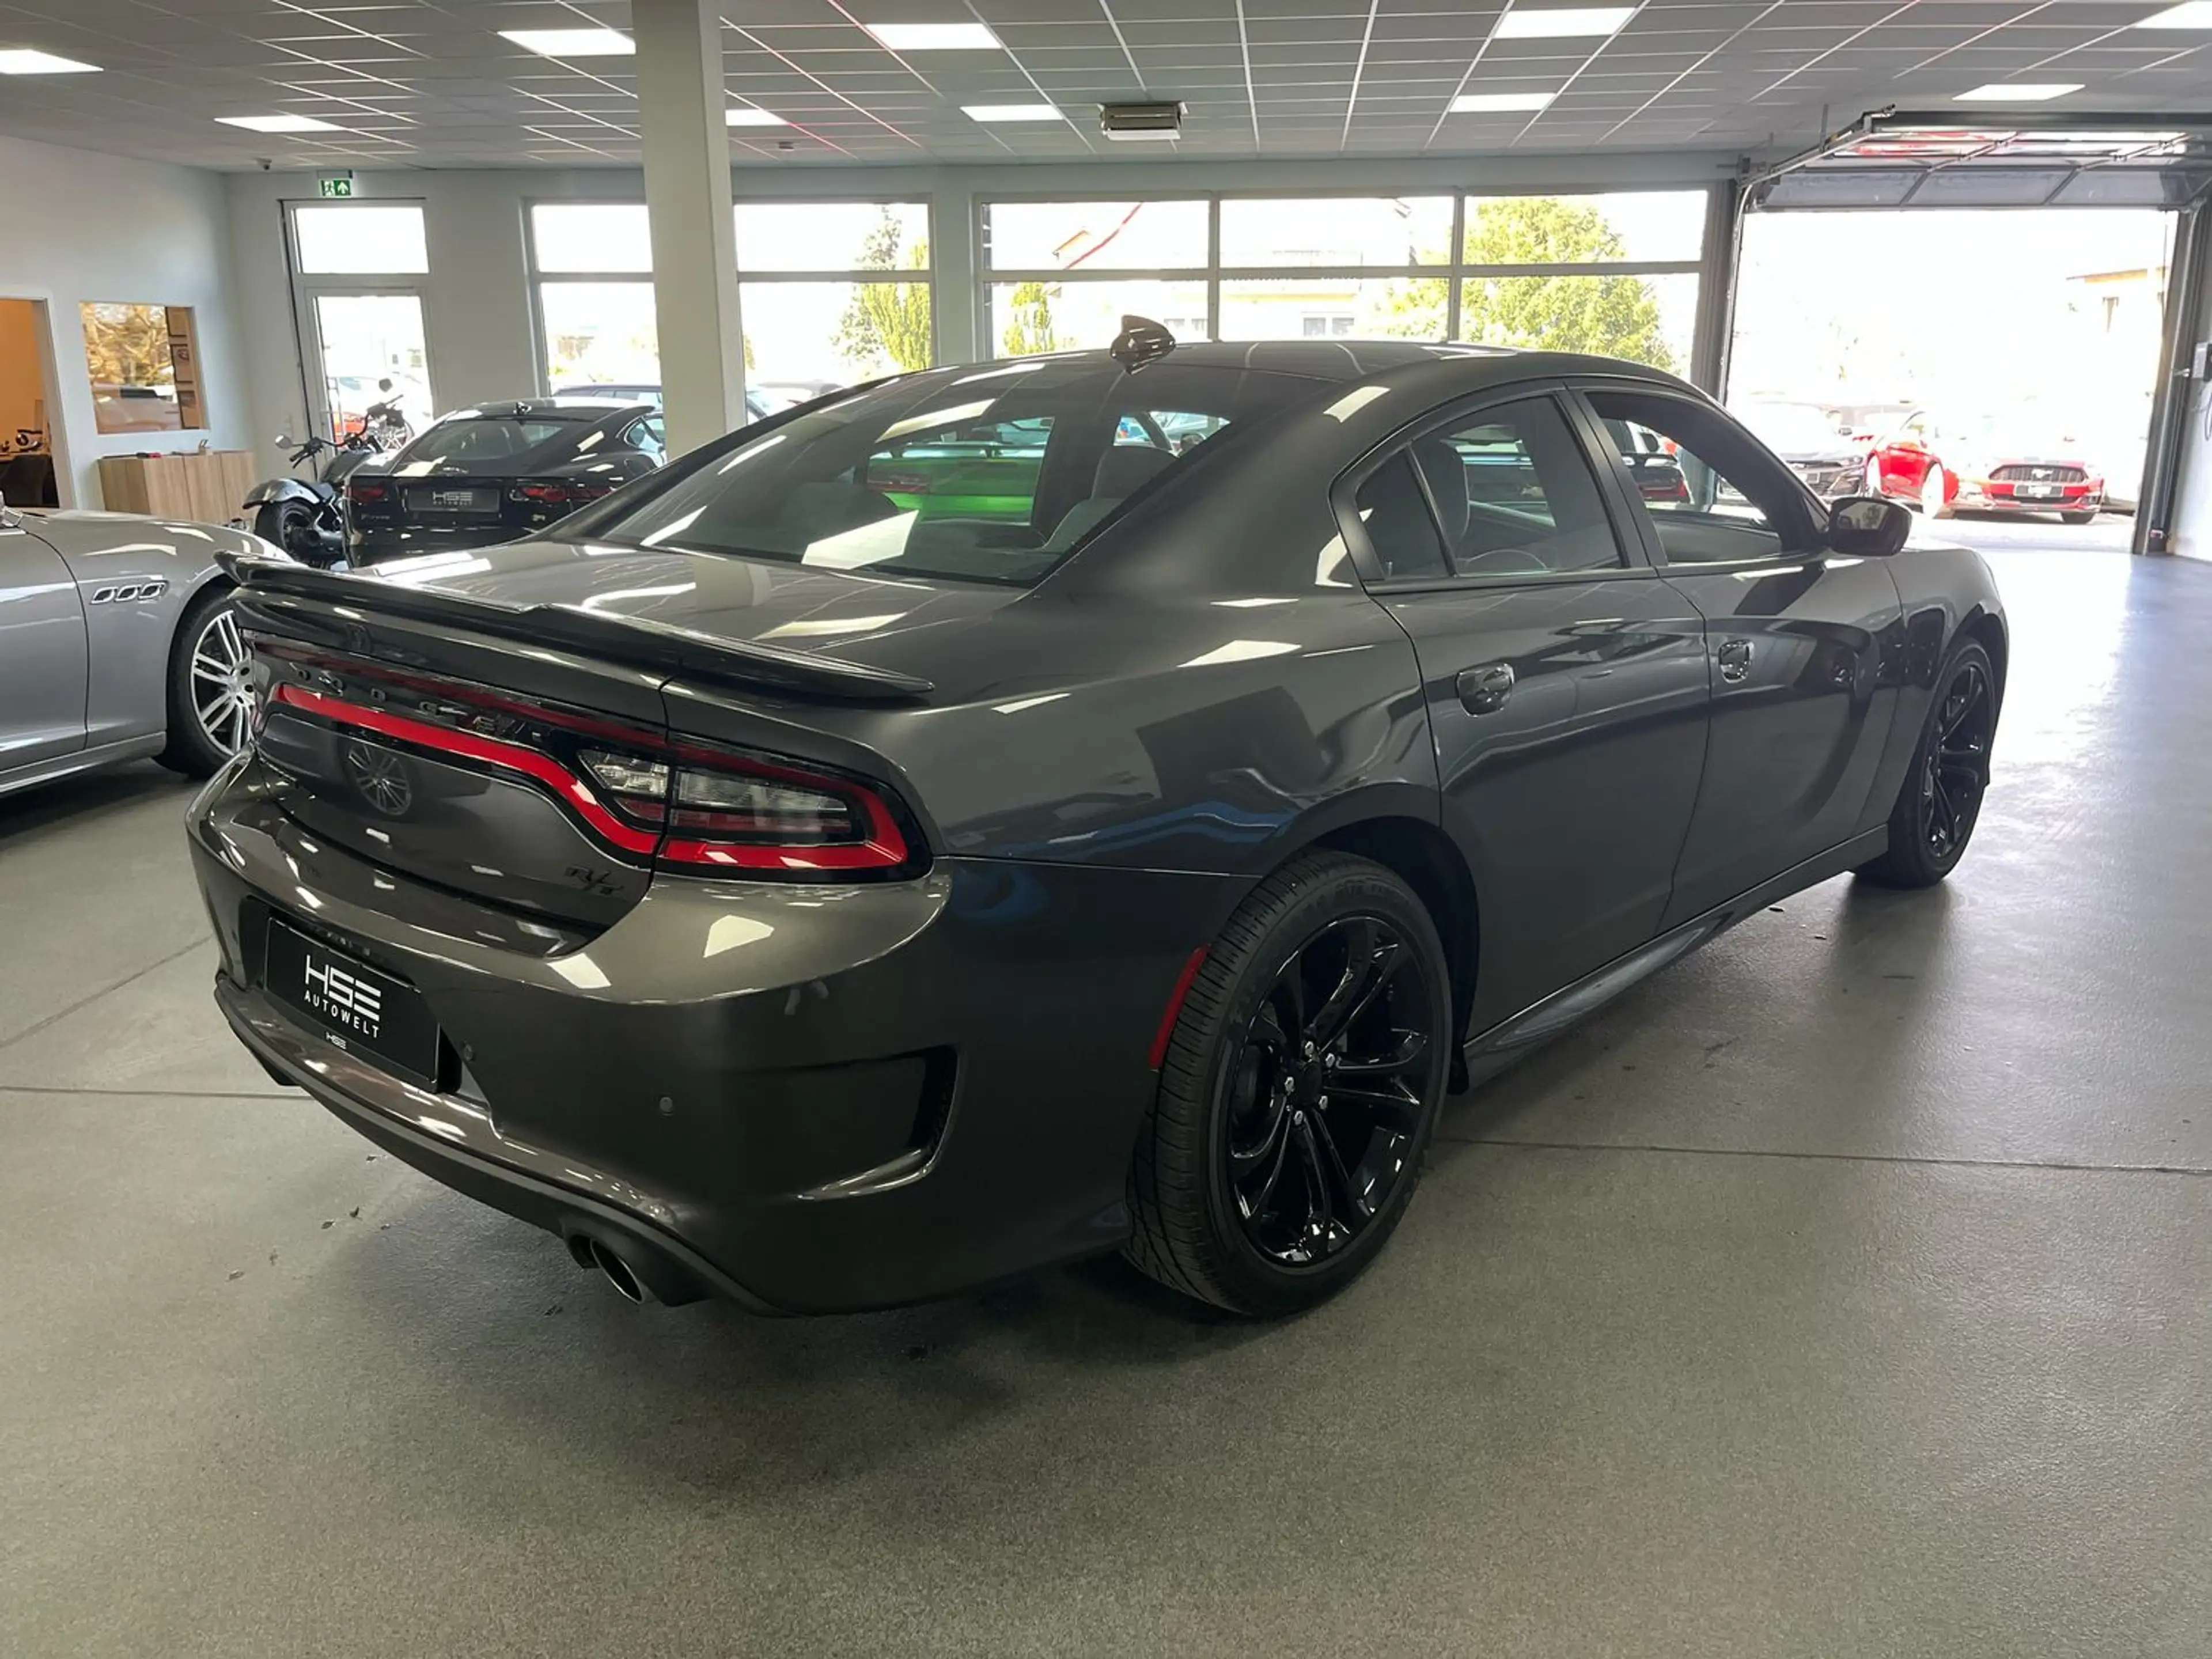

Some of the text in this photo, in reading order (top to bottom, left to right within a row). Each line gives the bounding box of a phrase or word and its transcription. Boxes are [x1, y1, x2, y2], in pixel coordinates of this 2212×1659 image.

[432, 491, 473, 501] HSE
[305, 954, 381, 1022] HSE
[304, 989, 379, 1039] AUTOWELT
